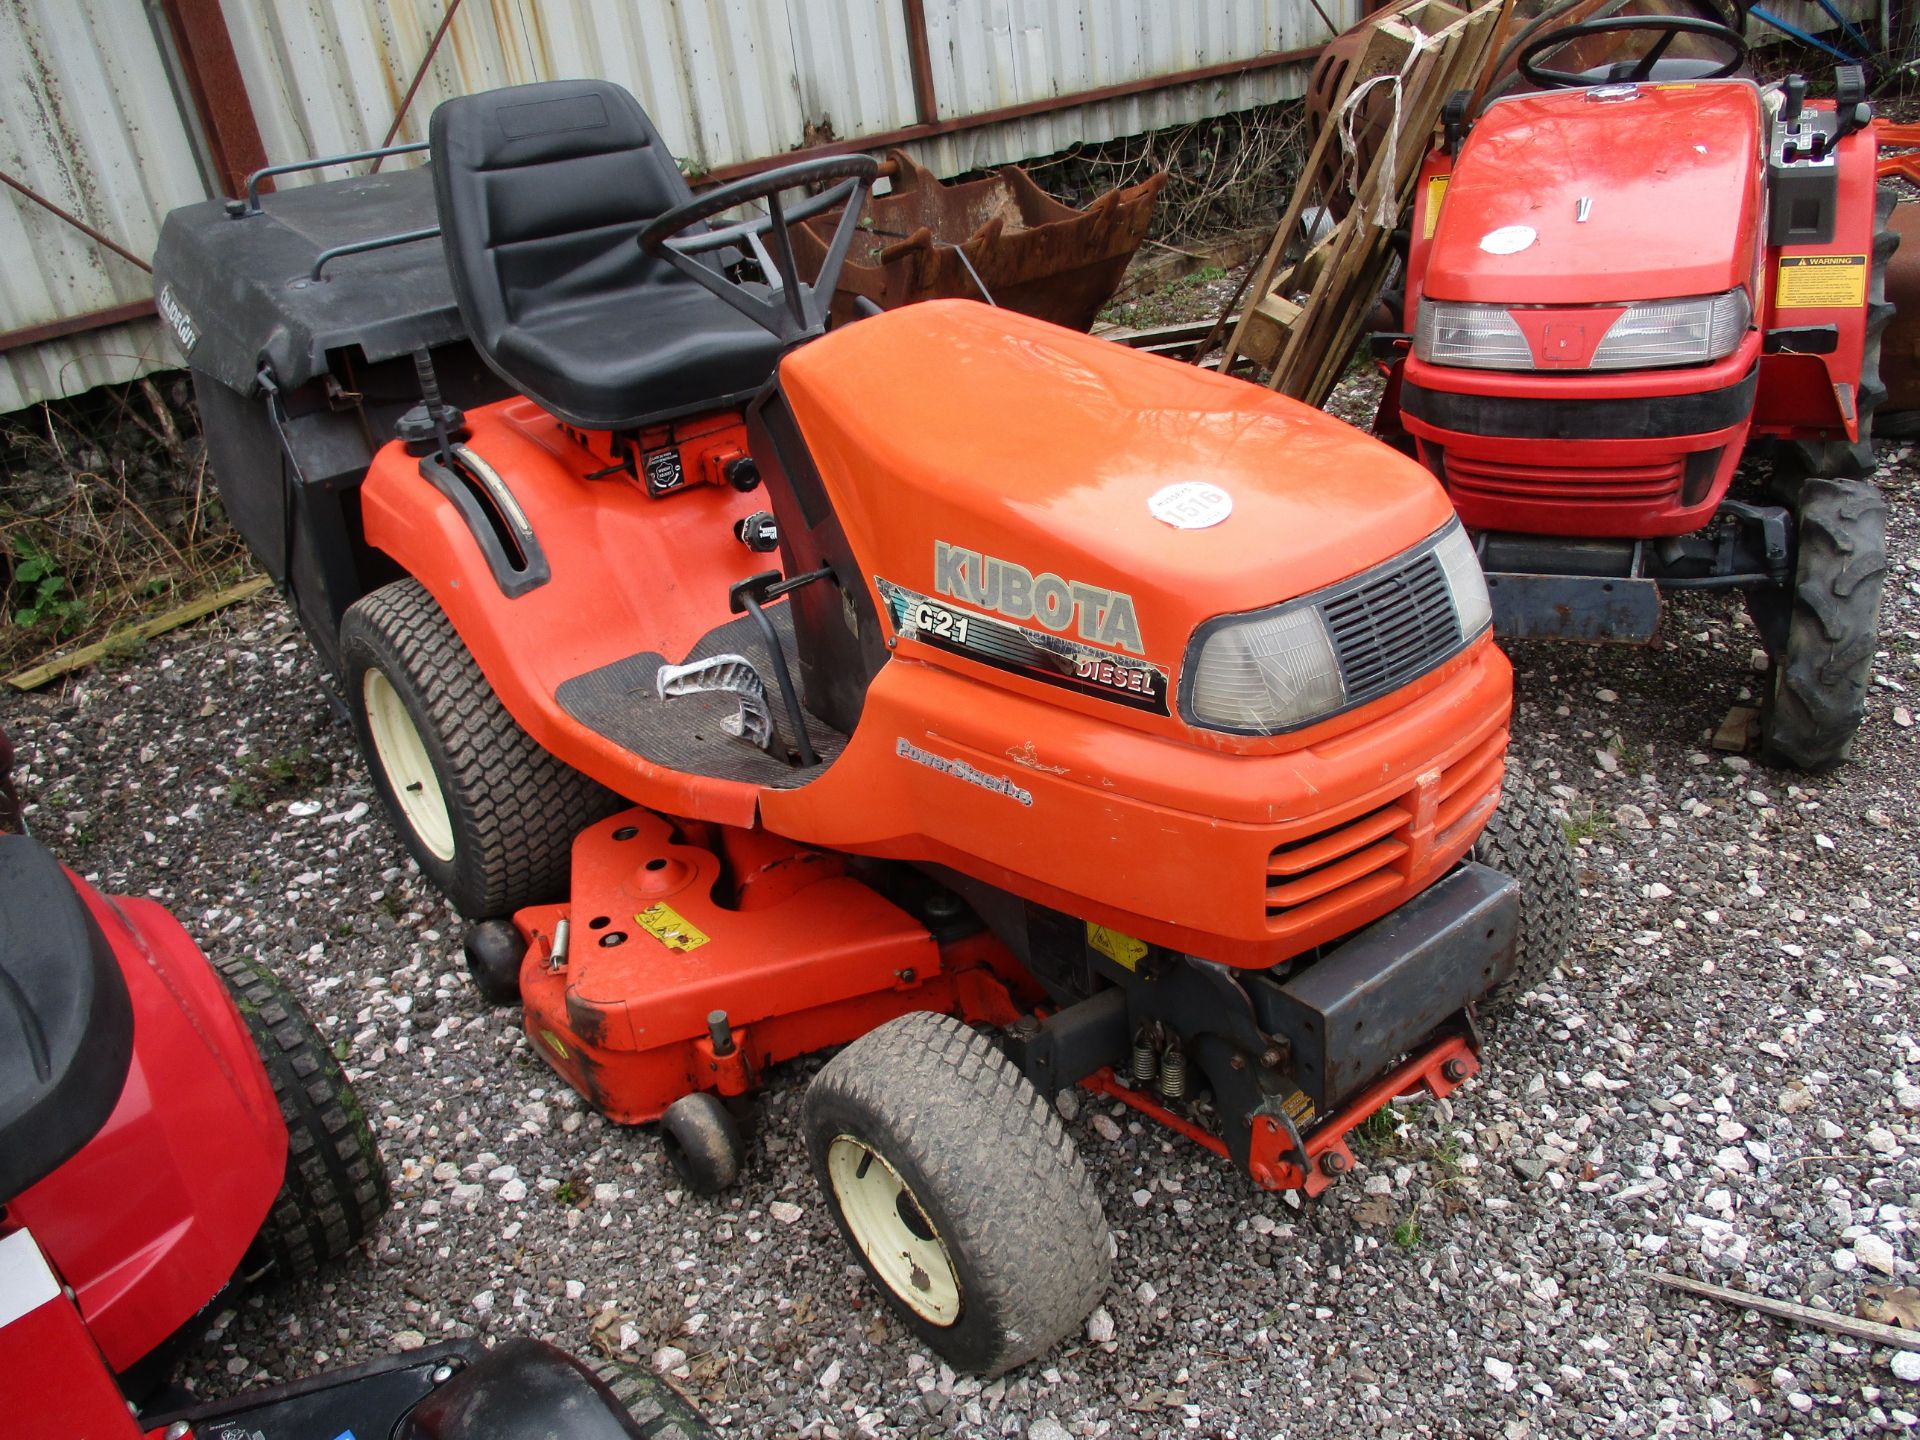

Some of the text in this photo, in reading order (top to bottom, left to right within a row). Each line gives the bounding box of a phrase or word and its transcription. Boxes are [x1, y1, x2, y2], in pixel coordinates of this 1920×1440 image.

[1809, 257, 1852, 265] WARNING
[1164, 489, 1223, 522] 1516
[933, 539, 1145, 656] KUBOTA
[1076, 661, 1156, 696] DIESEL
[895, 736, 953, 773] Power
